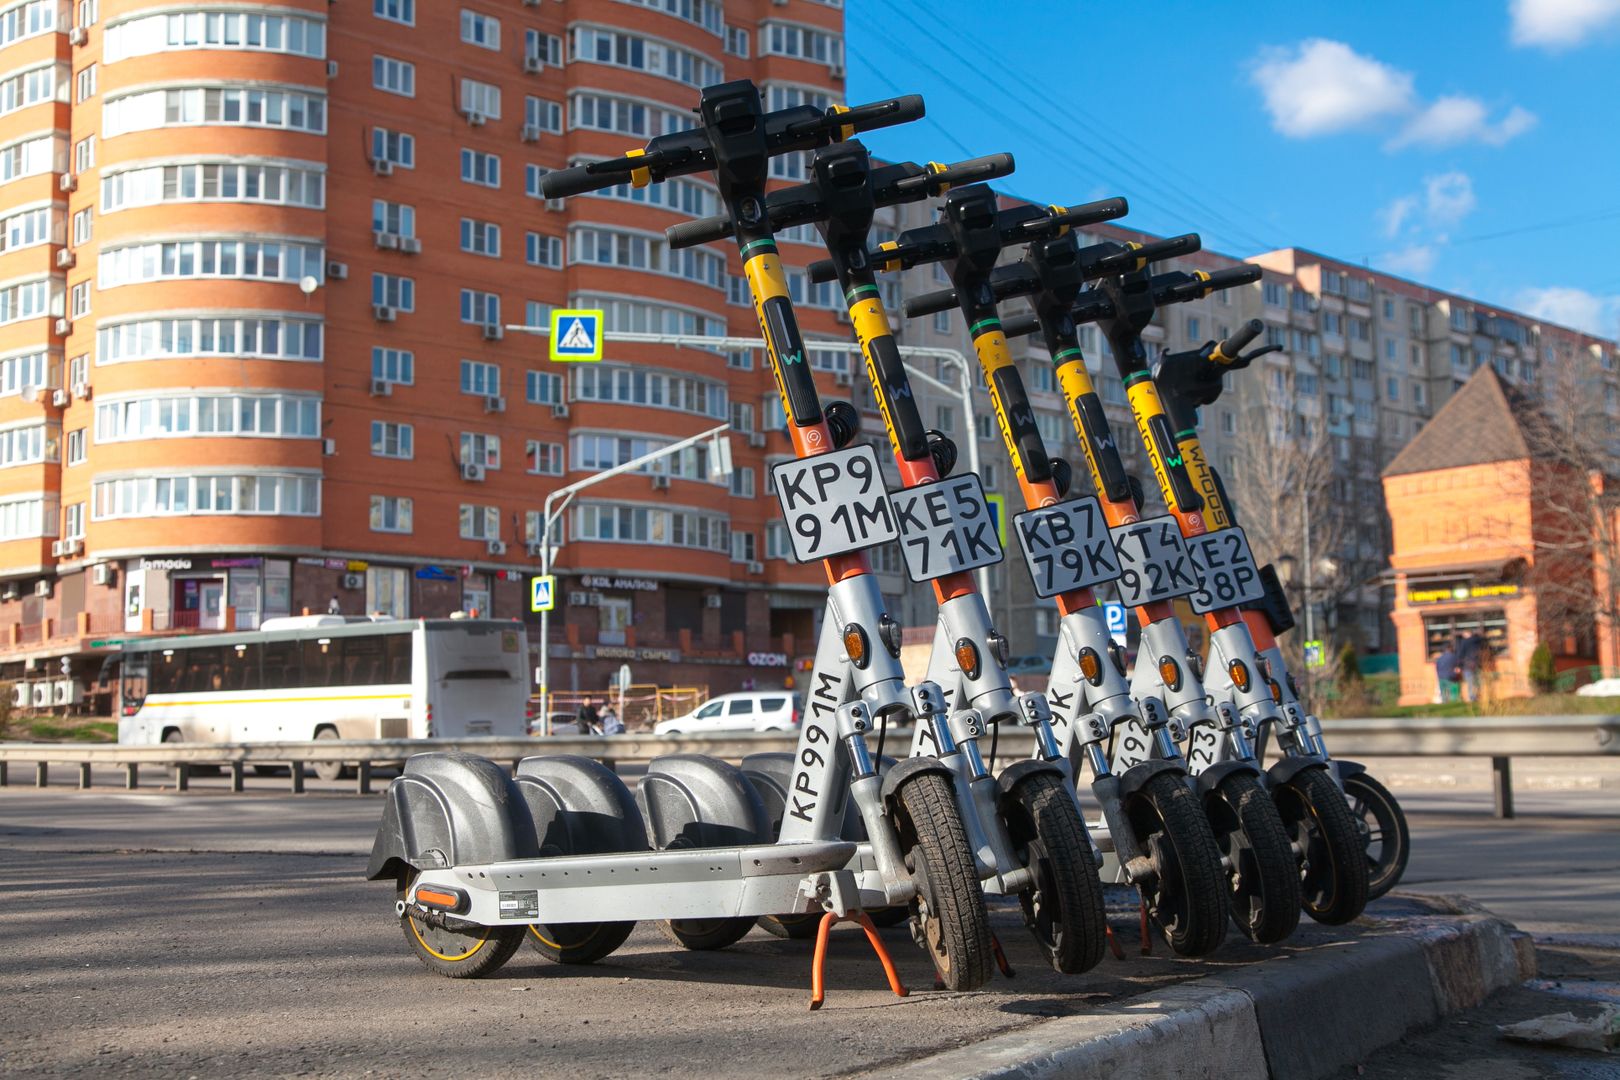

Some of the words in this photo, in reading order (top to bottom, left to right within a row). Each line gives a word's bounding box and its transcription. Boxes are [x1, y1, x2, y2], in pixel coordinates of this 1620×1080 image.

[780, 455, 873, 510] KP9
[1190, 445, 1230, 530] WHOOS
[795, 496, 894, 553] 91M
[894, 483, 981, 536] KE5
[1020, 503, 1093, 553] KB7
[907, 522, 996, 574] 71K
[1033, 540, 1115, 590] 79K
[1121, 556, 1194, 600] 92K
[748, 652, 787, 666] OZON
[790, 672, 841, 822] KP991M
